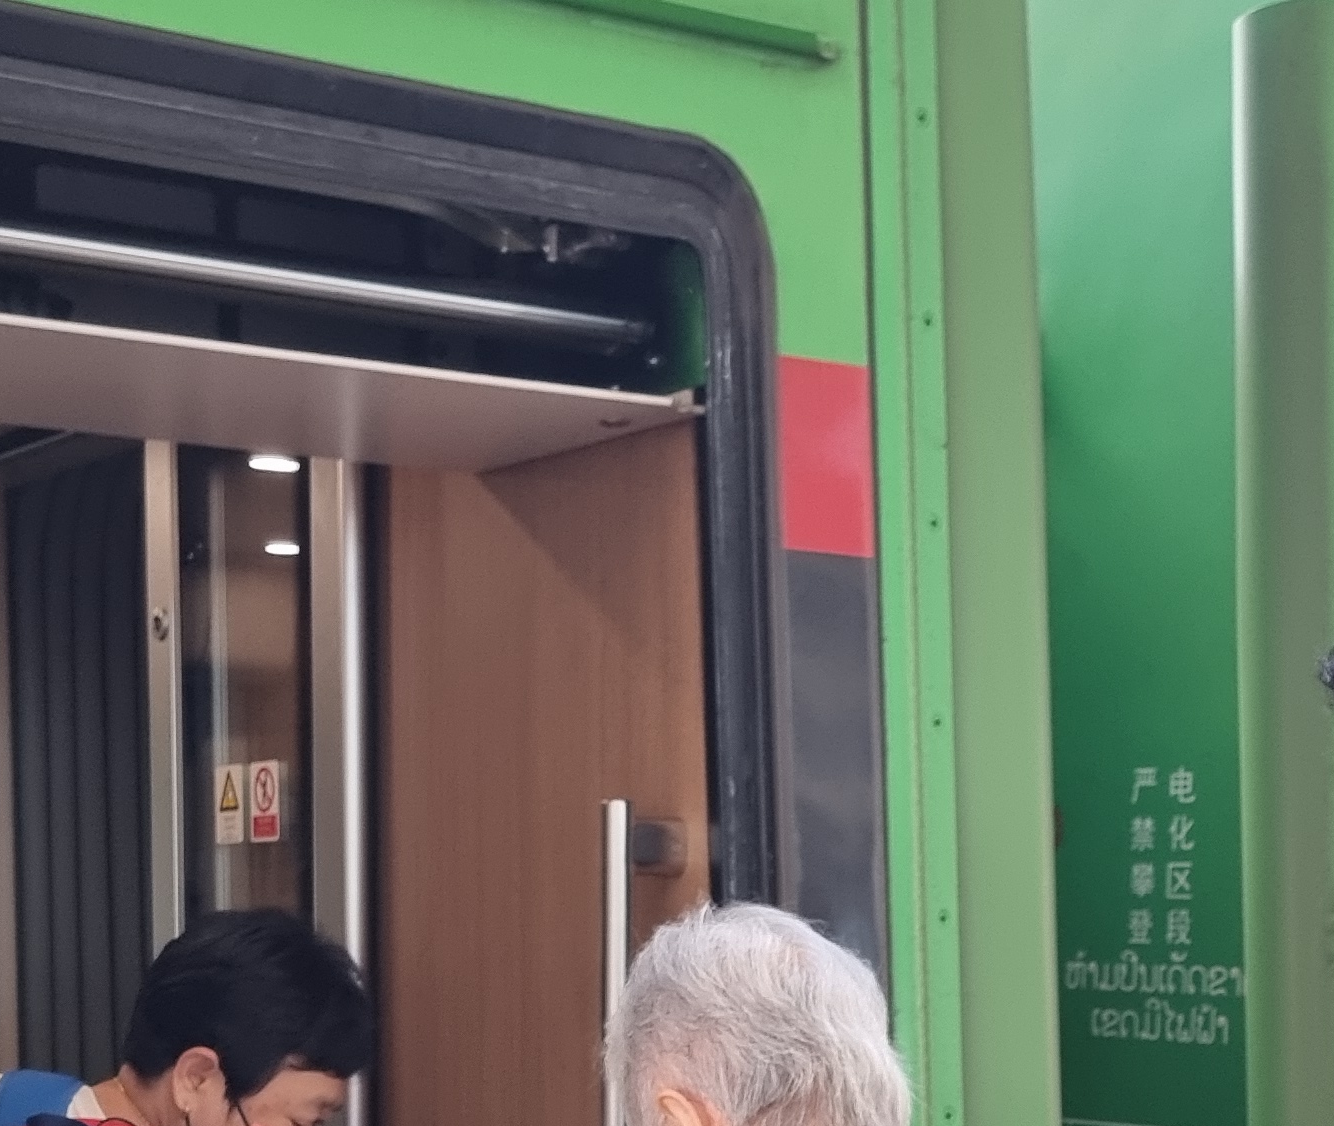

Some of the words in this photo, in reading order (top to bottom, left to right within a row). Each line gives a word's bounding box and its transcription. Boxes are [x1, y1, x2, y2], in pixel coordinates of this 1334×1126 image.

[1128, 767, 1158, 945] 严禁攀登
[1165, 766, 1196, 945] 电化区段
